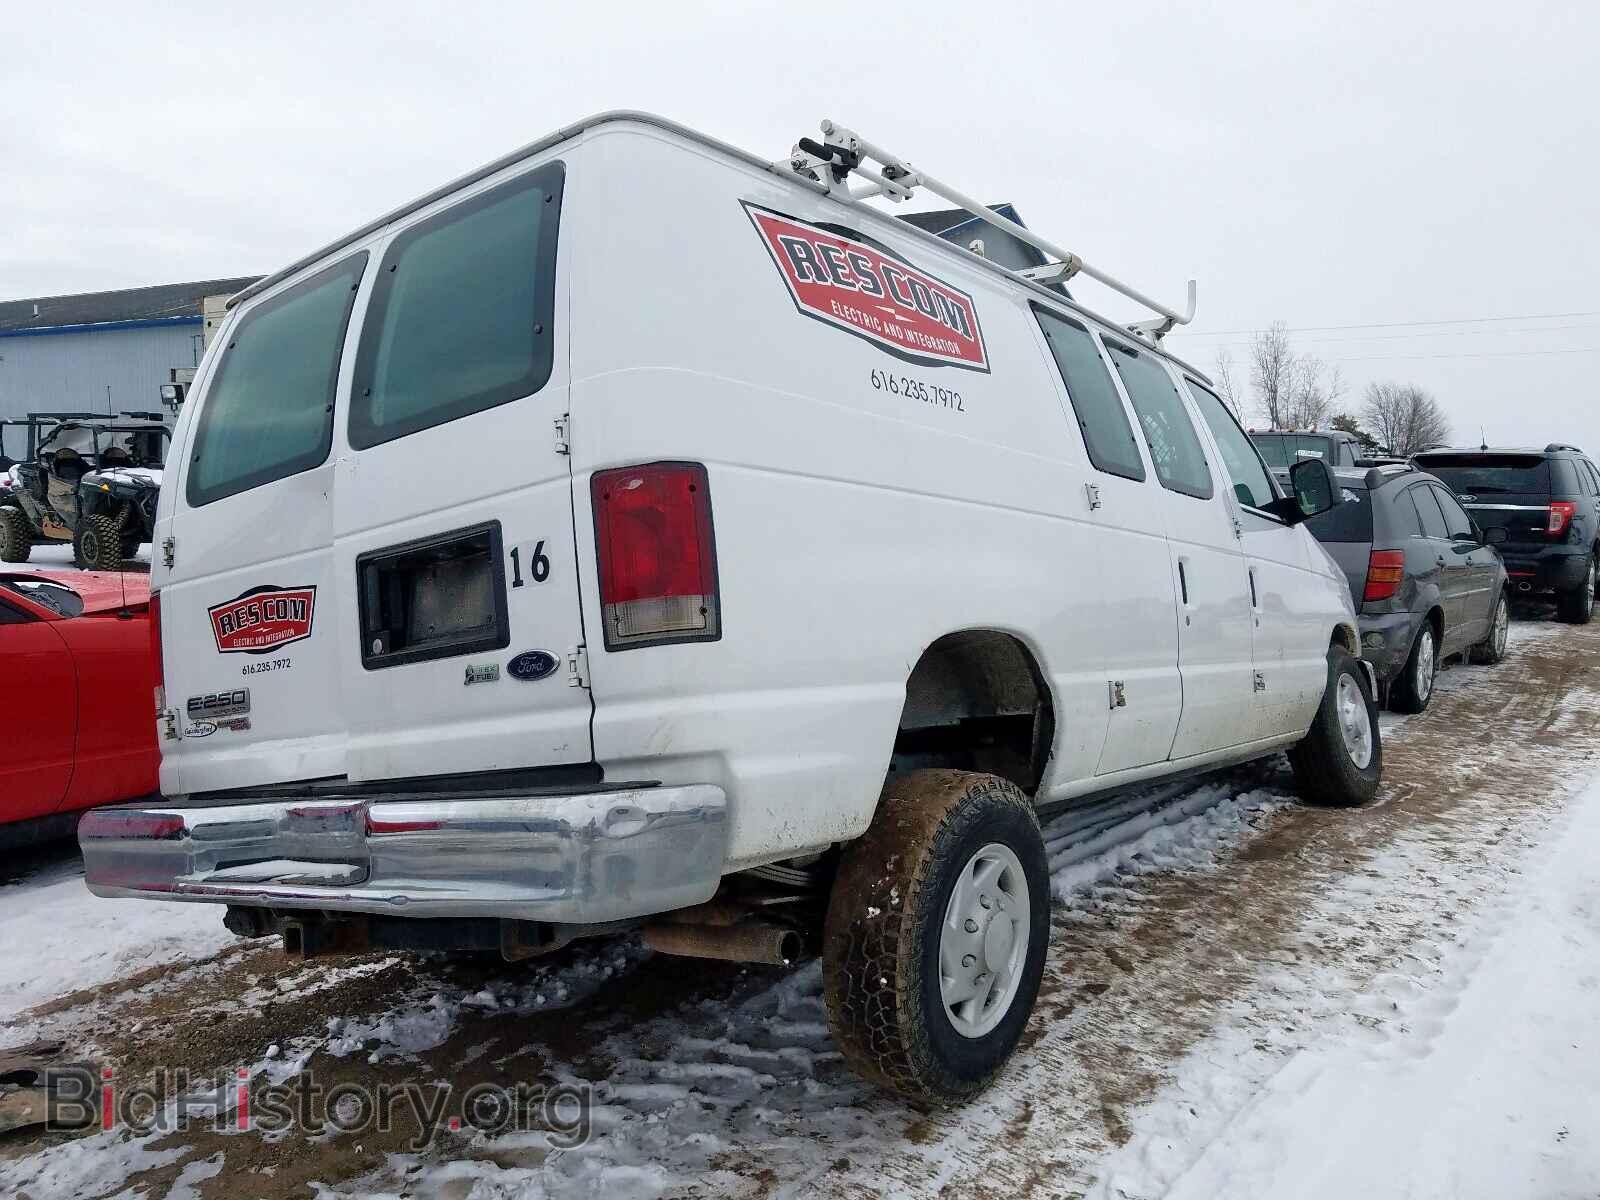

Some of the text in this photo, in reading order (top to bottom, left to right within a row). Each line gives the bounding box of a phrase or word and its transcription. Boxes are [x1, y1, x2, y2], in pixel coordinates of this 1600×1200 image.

[831, 299, 962, 356] ELECTRIC AND INTEGRATION
[871, 369, 965, 412] 616.235.7972
[510, 541, 549, 588] 16
[242, 658, 291, 675] 616.235.7972
[518, 656, 544, 674] Ford
